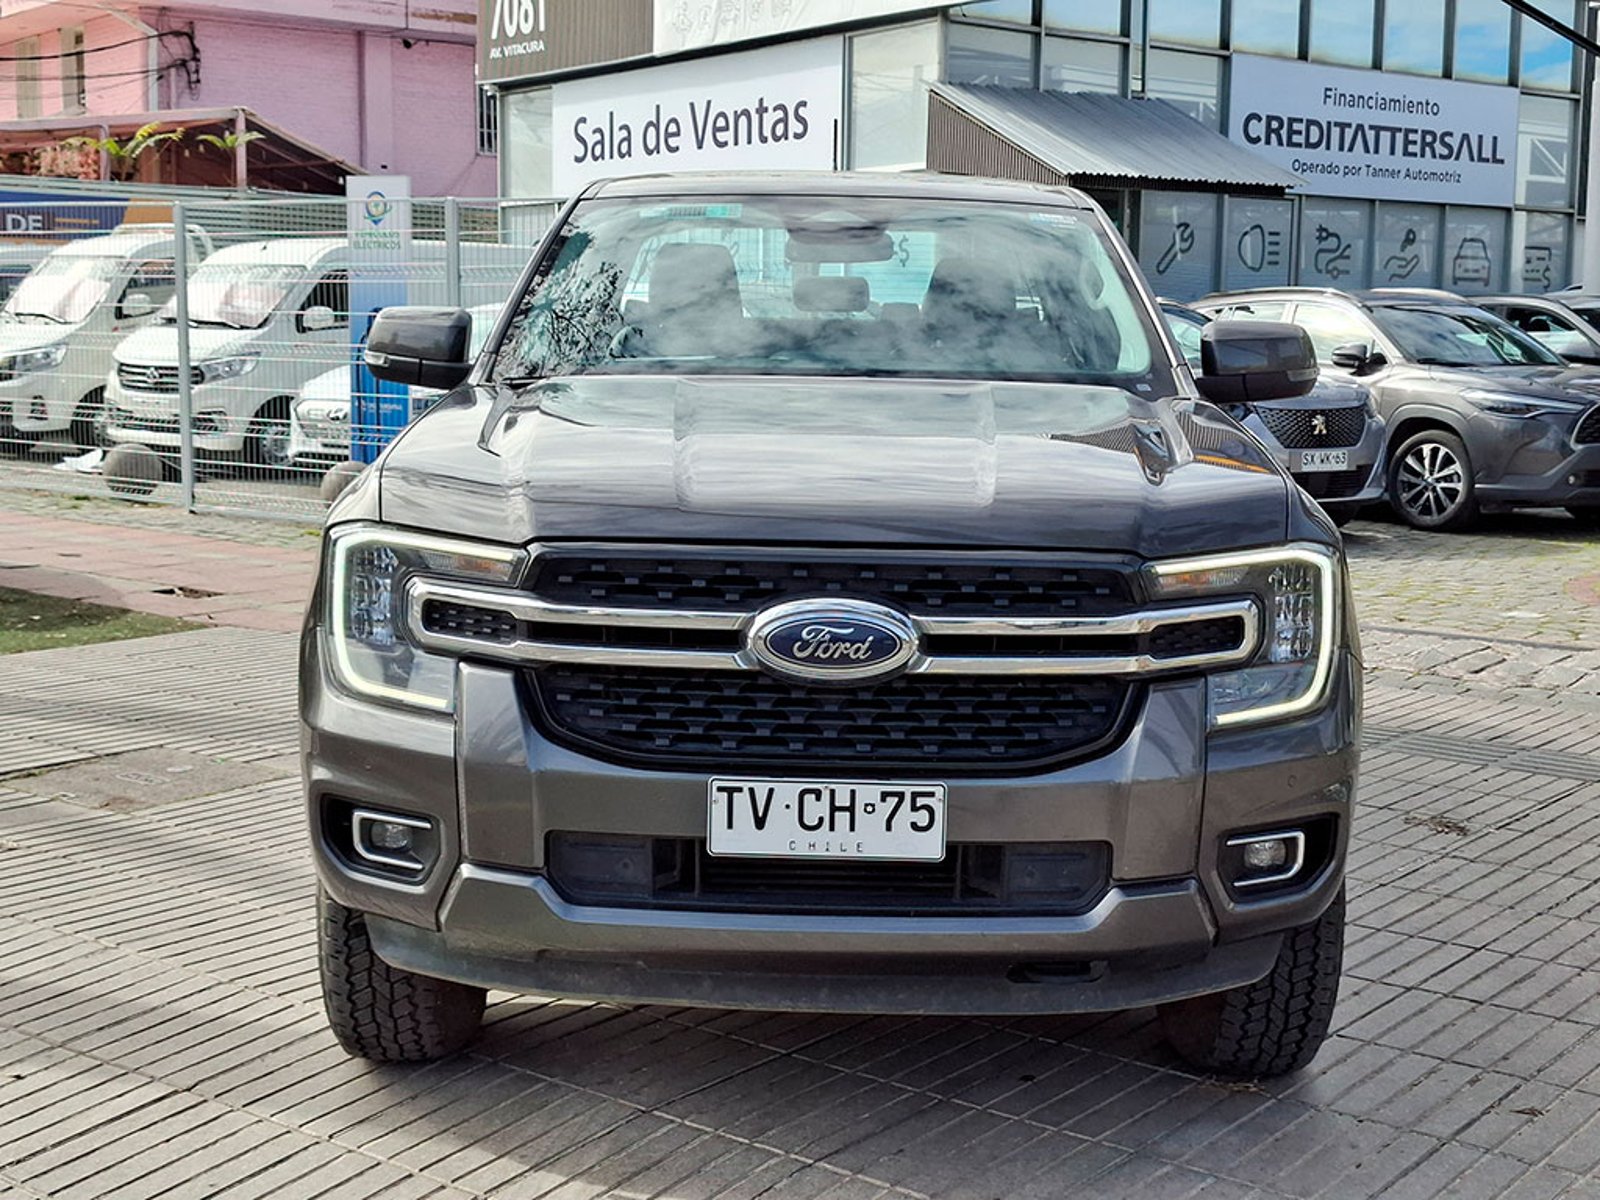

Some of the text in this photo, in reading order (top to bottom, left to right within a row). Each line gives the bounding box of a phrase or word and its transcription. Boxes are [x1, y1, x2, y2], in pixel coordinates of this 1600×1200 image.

[503, 40, 545, 57] VITACURA
[1323, 87, 1440, 116] Financiamiento
[573, 97, 809, 164] Sala de Ventas
[1242, 112, 1505, 165] CREDITATTERSALL
[1292, 158, 1462, 184] Operado por Tanner Automotriz
[5, 213, 43, 231] DE
[793, 624, 873, 659] Ford
[789, 840, 863, 853] CHILE
